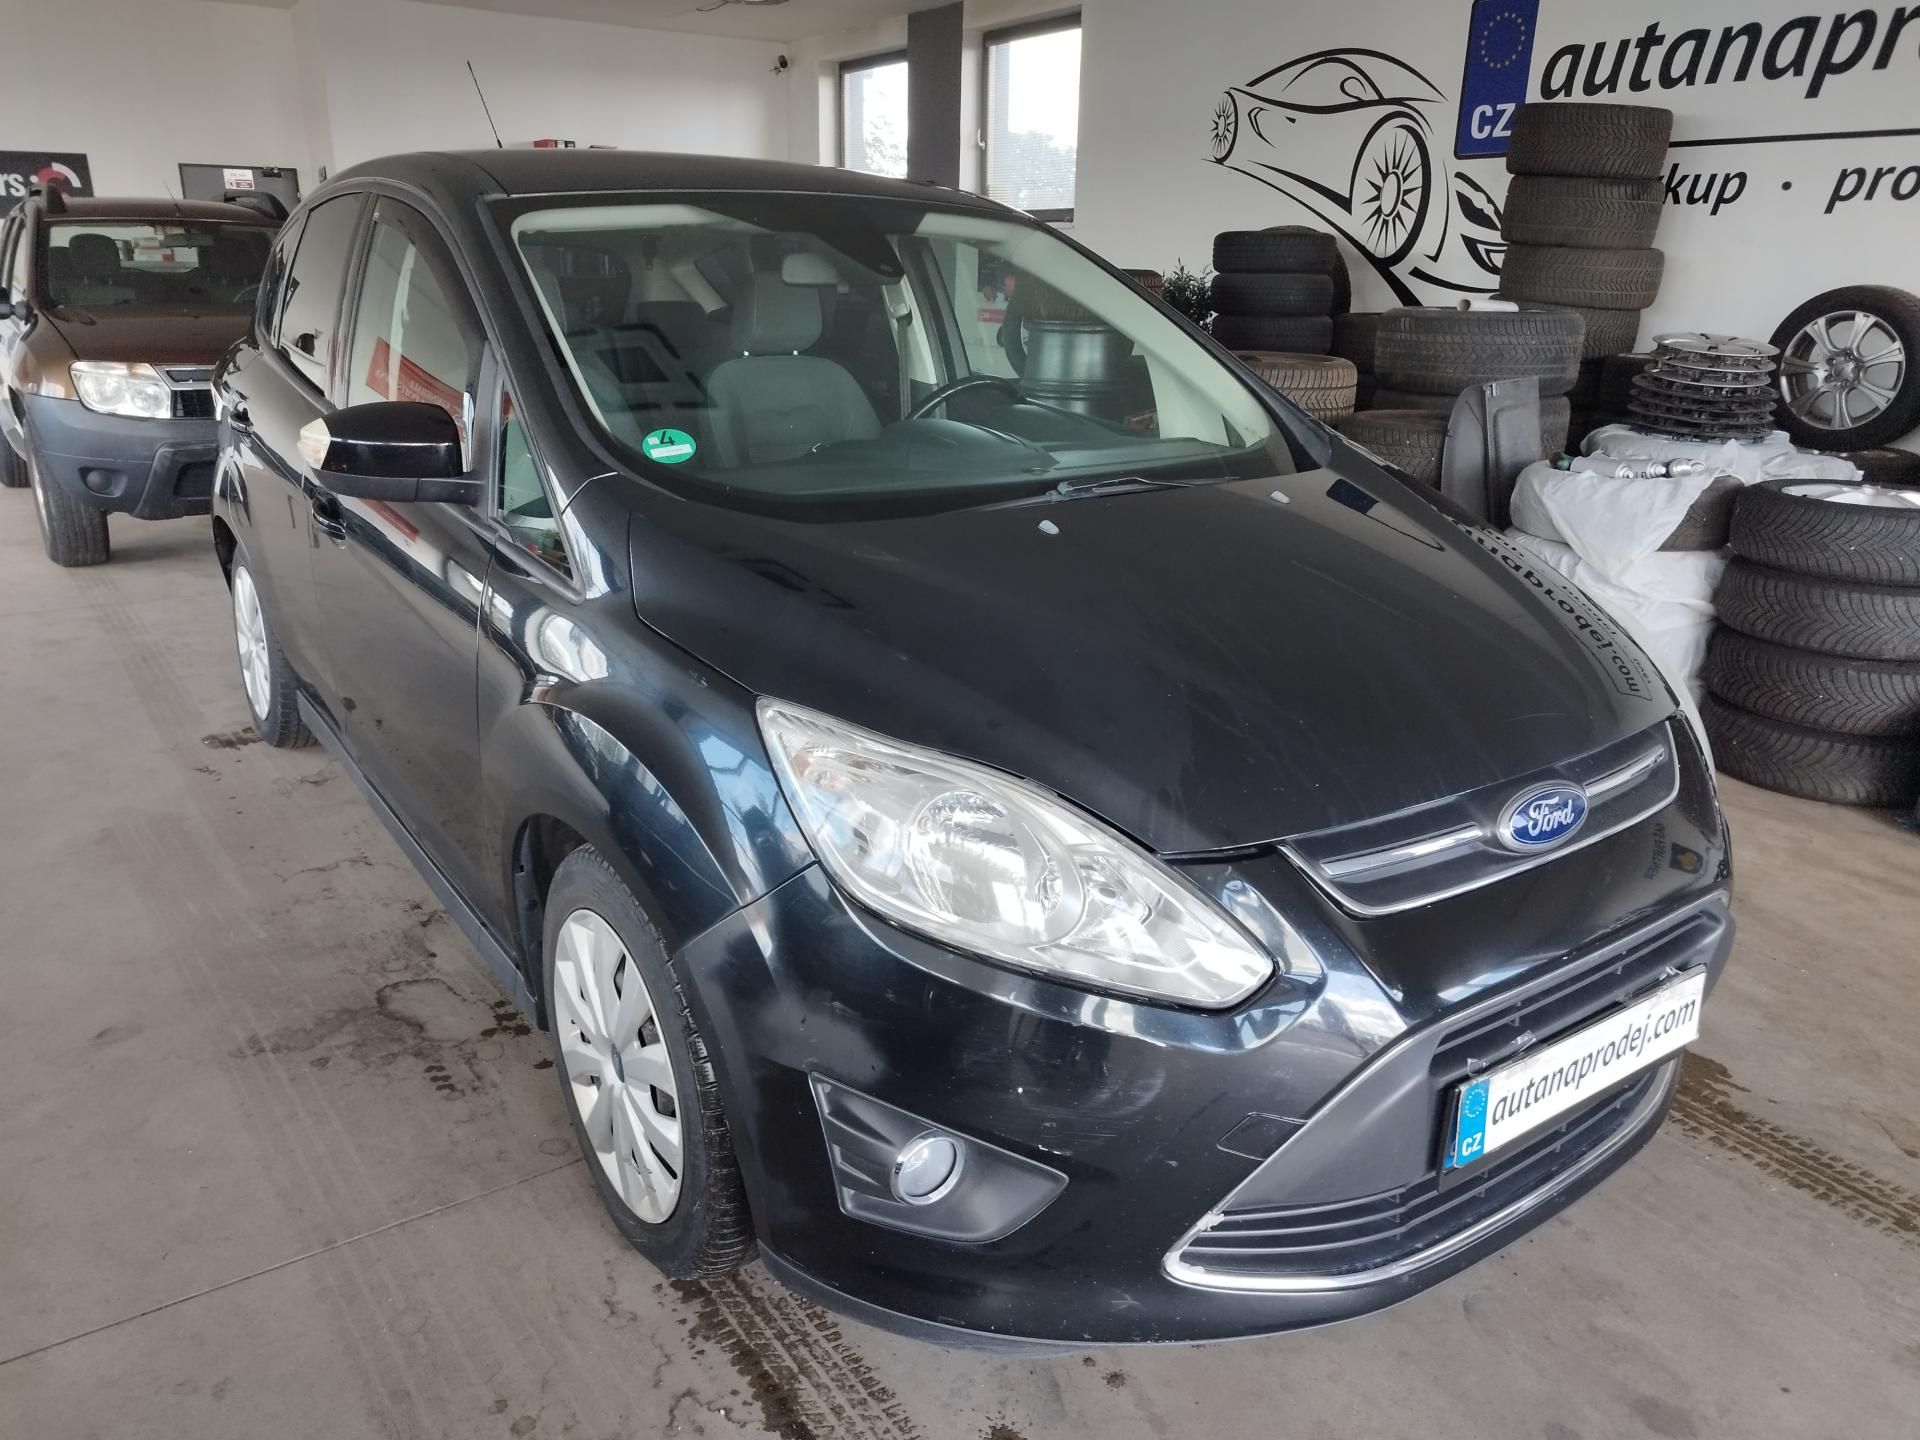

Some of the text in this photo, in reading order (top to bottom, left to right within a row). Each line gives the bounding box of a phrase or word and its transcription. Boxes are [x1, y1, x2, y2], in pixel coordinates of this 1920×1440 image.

[1540, 4, 1920, 100] autanapr
[1470, 103, 1516, 140] CZ
[1659, 163, 1748, 216] kup
[660, 430, 676, 446] 4
[1528, 796, 1575, 837] Ford
[1491, 999, 1697, 1127] autanaprodej.com
[1462, 1131, 1483, 1157] CZ
